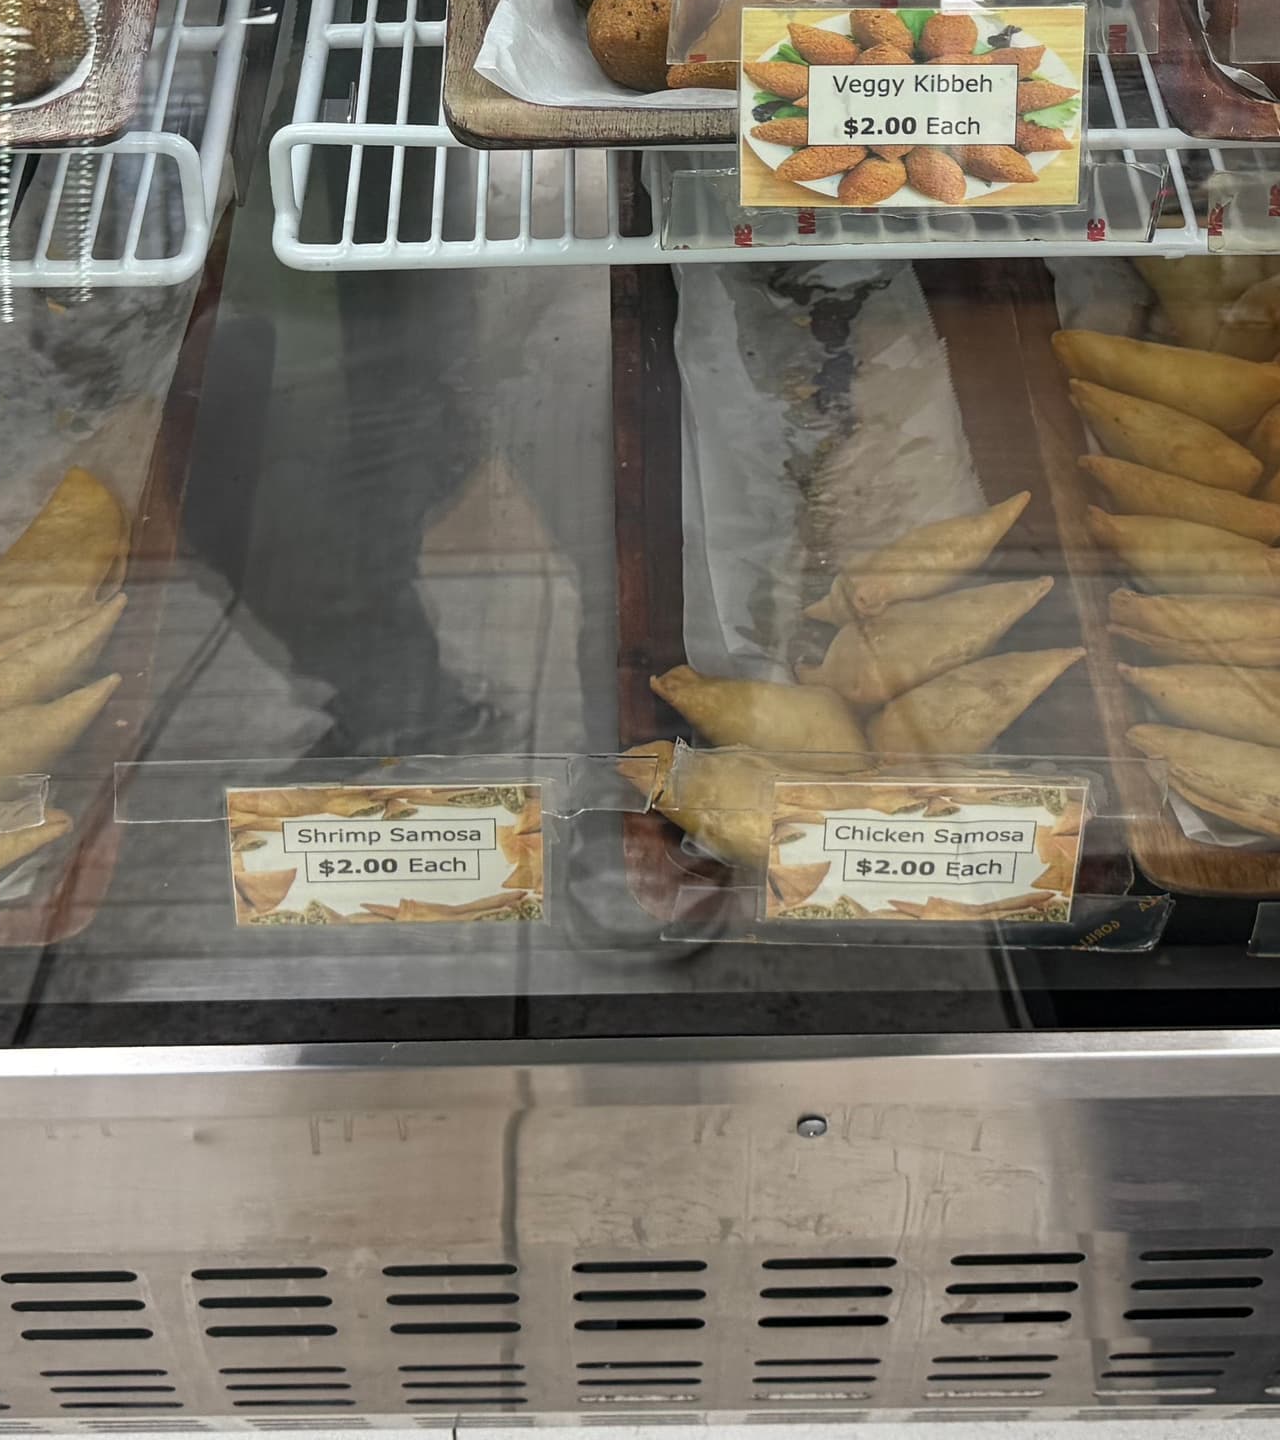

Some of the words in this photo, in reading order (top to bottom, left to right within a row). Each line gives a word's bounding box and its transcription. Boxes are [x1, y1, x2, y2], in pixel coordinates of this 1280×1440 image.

[832, 75, 904, 97] Veggy
[914, 75, 992, 93] Kibbeh
[844, 117, 916, 137] $2.00
[927, 117, 980, 135] Each
[297, 828, 380, 847] Shrimp
[390, 827, 481, 842] Samosa
[834, 826, 924, 843] Chicken
[934, 828, 1024, 843] Samosa
[319, 858, 397, 877] $2.00
[409, 857, 466, 872] Each
[856, 858, 935, 876] $2.00
[946, 860, 1002, 876] Each
